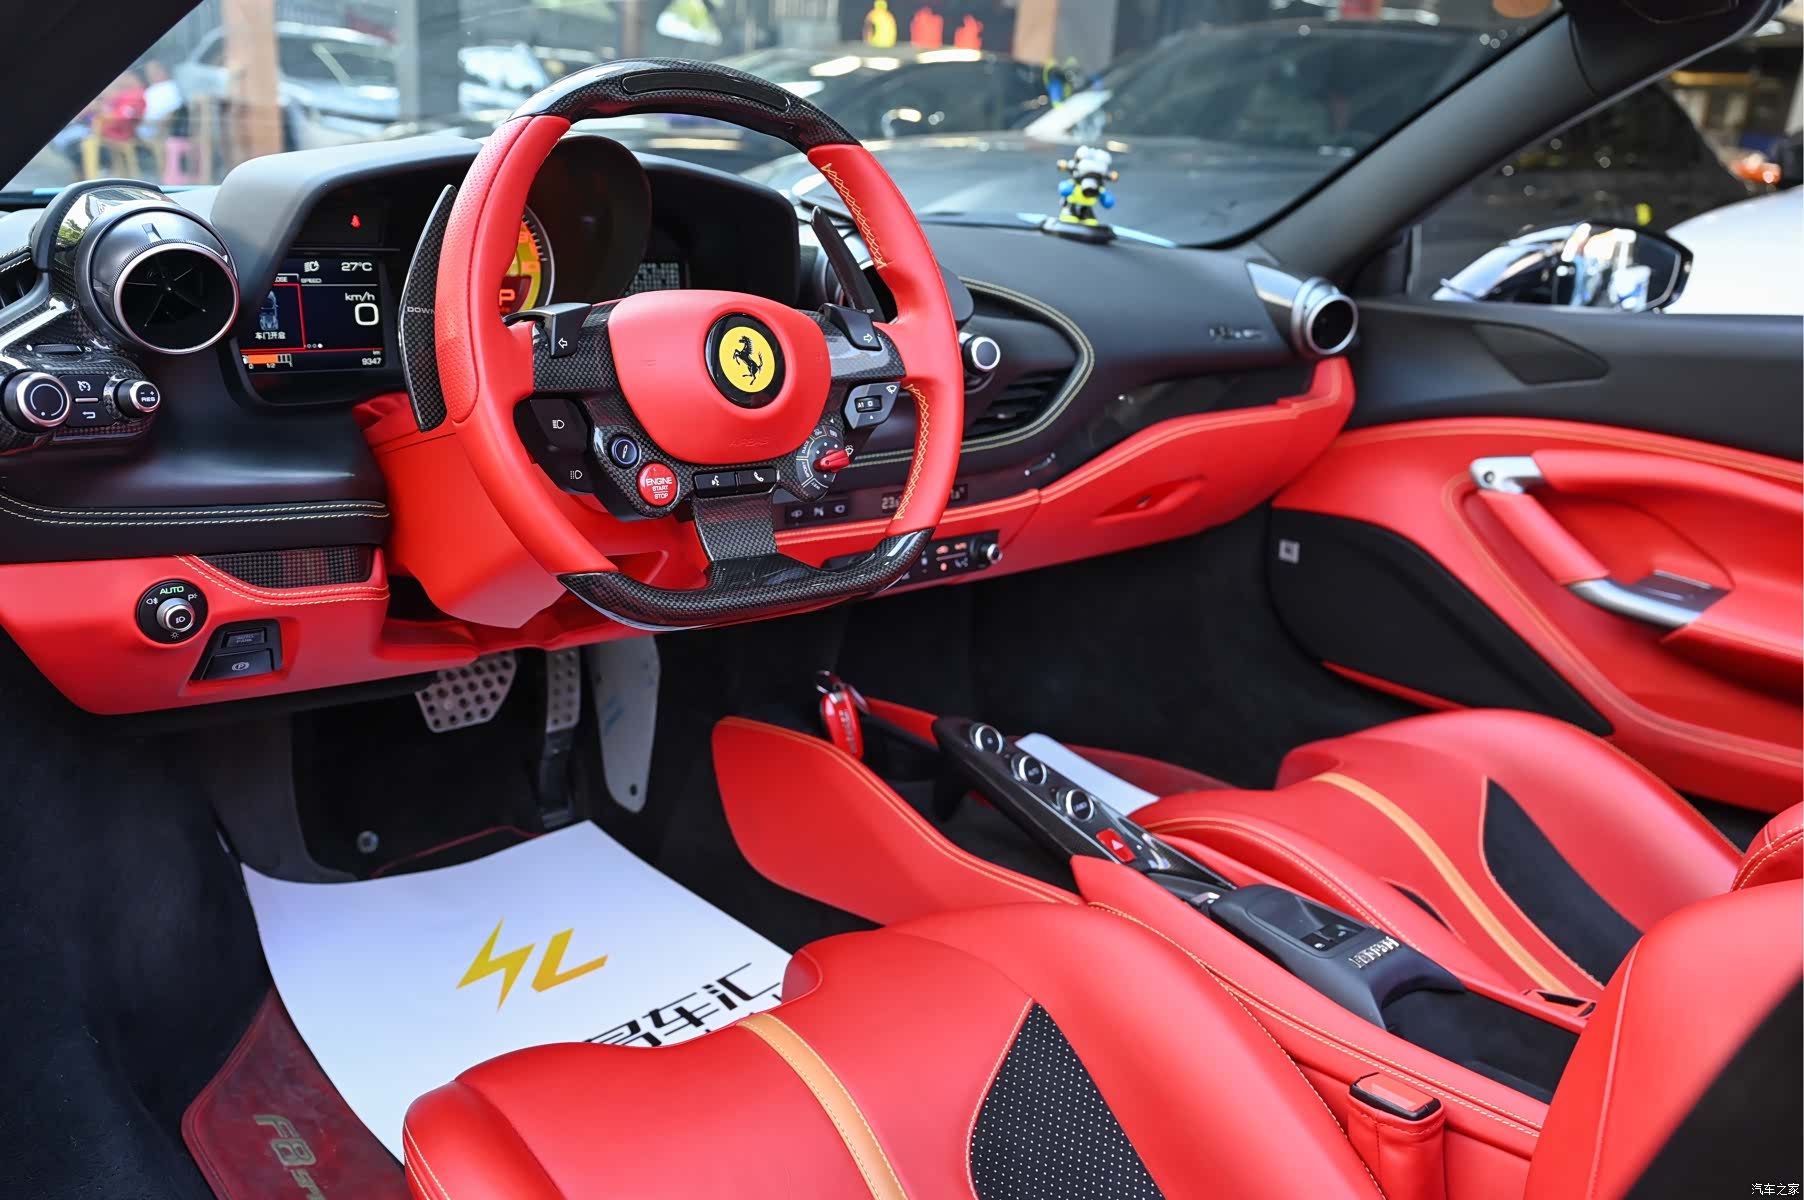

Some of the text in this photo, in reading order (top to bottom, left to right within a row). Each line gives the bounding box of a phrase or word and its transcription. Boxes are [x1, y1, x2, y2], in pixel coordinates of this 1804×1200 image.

[341, 262, 373, 271] 27°C
[344, 291, 376, 302] km/h
[354, 302, 380, 326] 0
[646, 477, 672, 486] ENGINE
[159, 585, 185, 595] AUTO
[253, 1114, 317, 1167] F8
